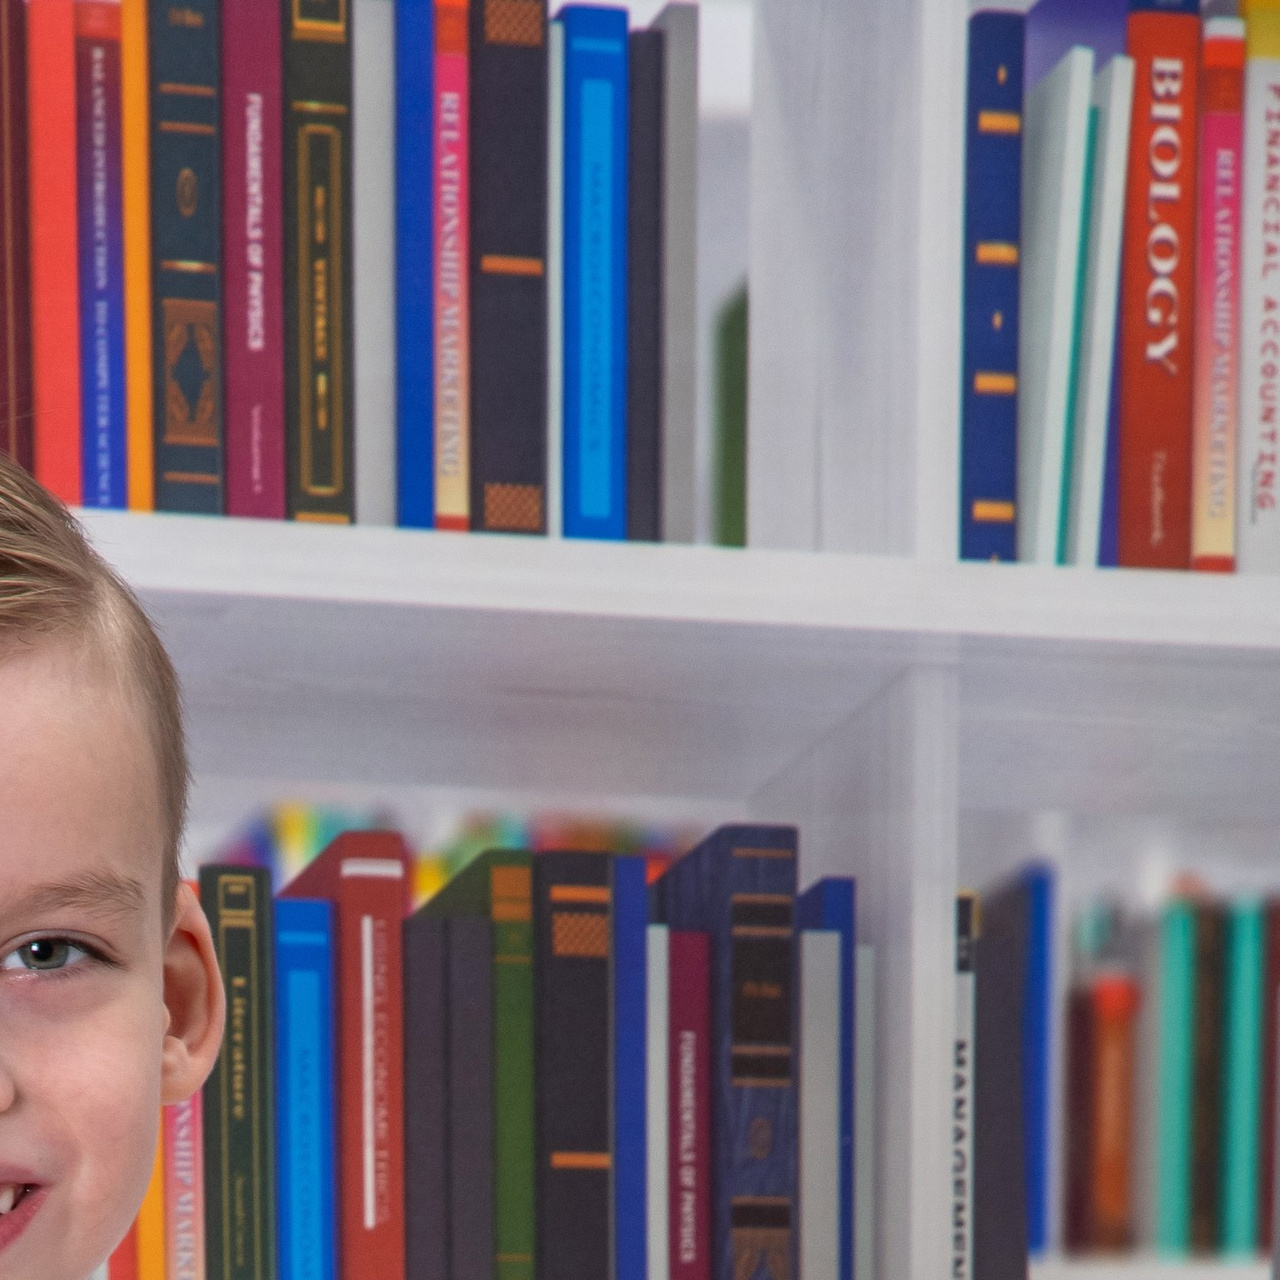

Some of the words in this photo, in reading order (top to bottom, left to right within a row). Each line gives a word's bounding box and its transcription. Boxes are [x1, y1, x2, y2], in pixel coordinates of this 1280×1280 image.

[246, 92, 265, 239] FUNDAMENTALS
[440, 91, 461, 298] RELATIONSHIP
[1145, 57, 1183, 376] BIOLOGY
[1211, 148, 1235, 346] RELATIONSHIP
[247, 242, 264, 268] OF
[248, 269, 265, 351] PHYSICS
[441, 303, 461, 477] MARKETING
[1207, 352, 1231, 520] MARKETING
[1256, 296, 1278, 511] ACCOUNTING
